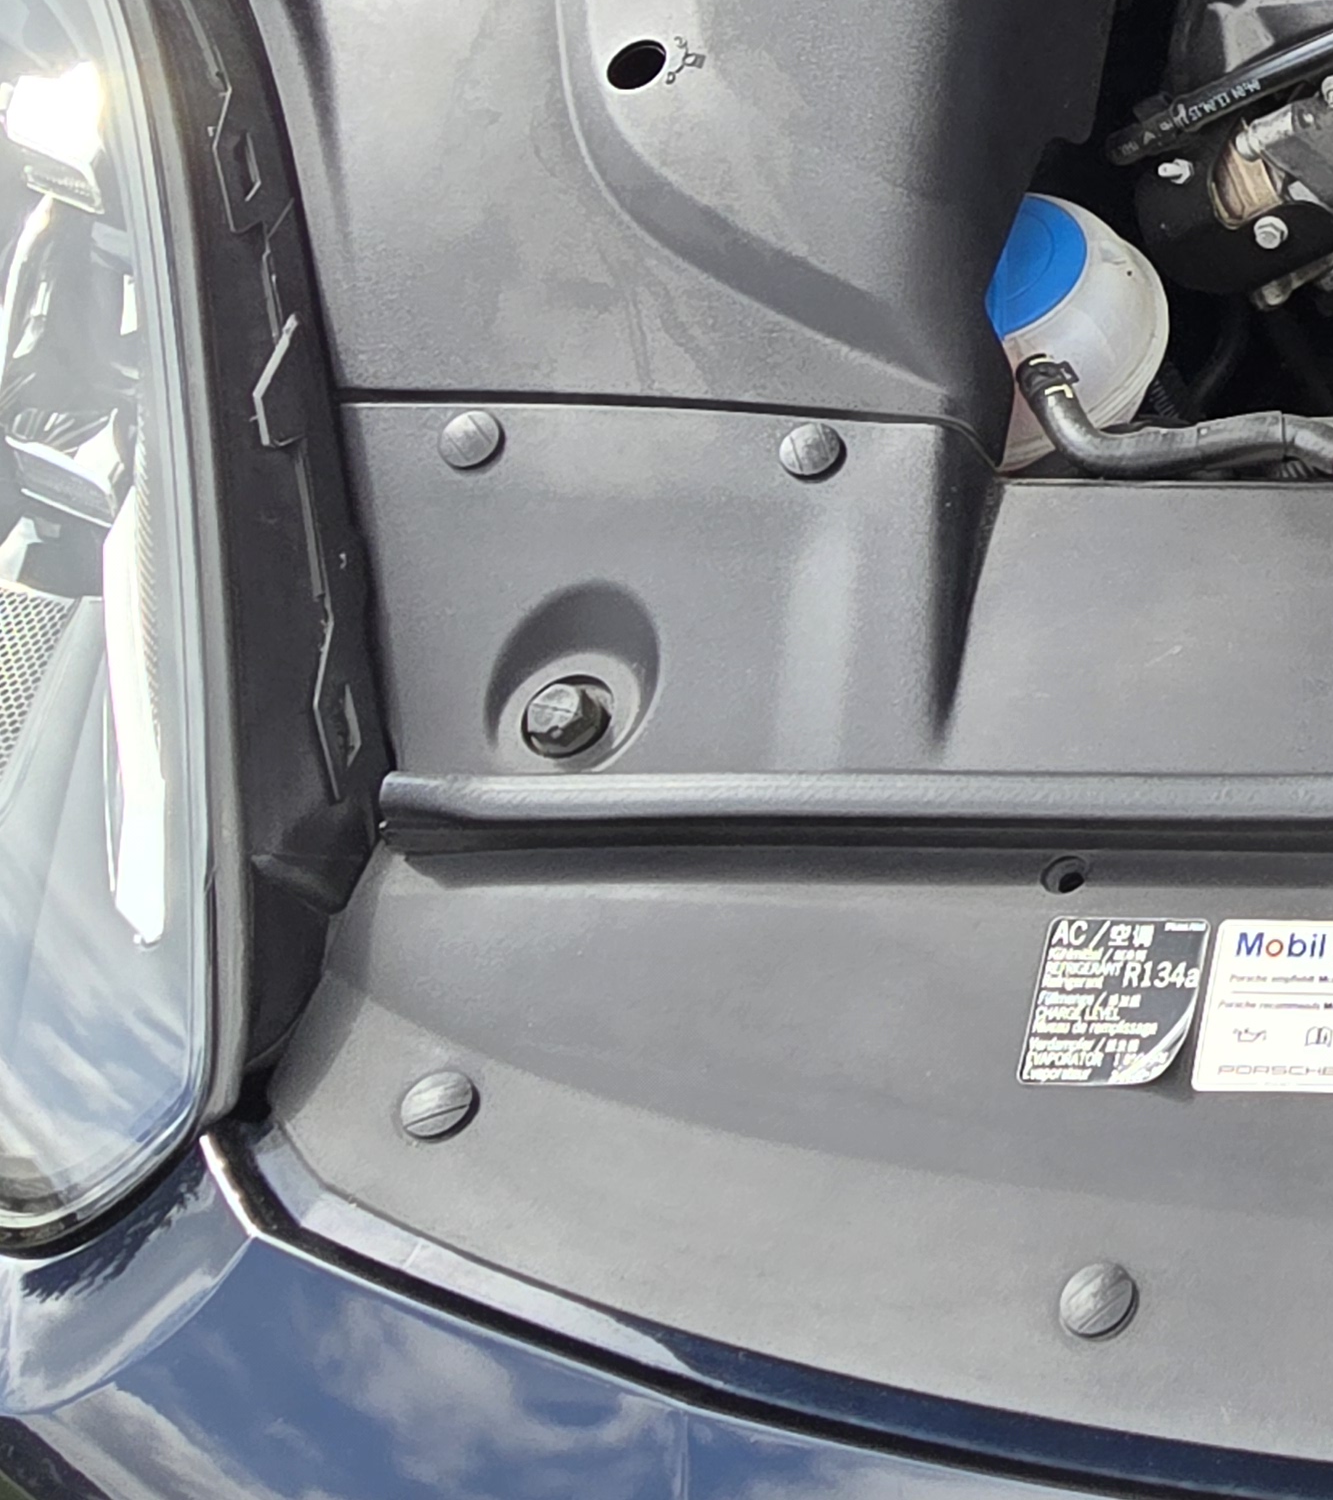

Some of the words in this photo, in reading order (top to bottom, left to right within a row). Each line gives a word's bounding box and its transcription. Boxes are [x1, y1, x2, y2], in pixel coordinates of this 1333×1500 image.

[1051, 920, 1088, 946] AC
[1235, 932, 1326, 959] Mobil
[1122, 961, 1200, 989] R134a
[1229, 974, 1267, 983] Porsche
